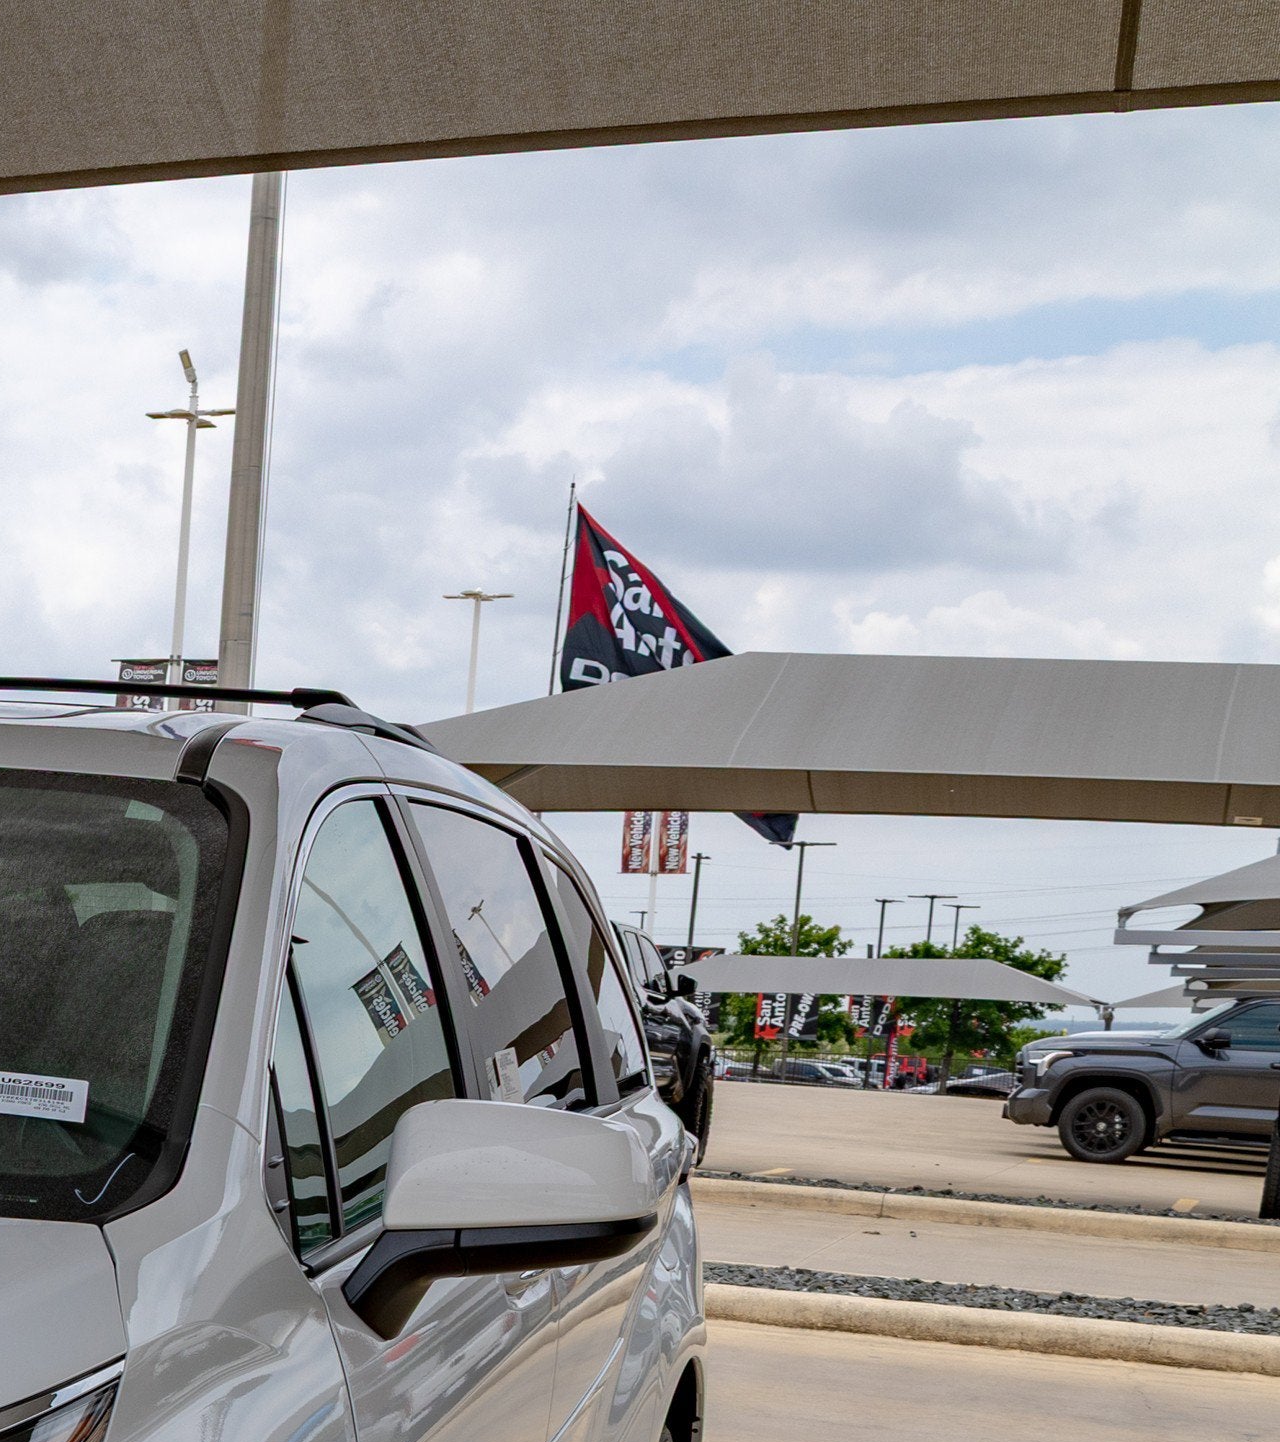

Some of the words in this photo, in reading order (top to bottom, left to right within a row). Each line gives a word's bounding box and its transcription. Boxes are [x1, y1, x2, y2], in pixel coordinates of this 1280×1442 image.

[628, 848, 643, 869] New
[665, 848, 680, 869] New
[757, 1000, 773, 1026] San
[788, 992, 815, 1037] PRE-OW
[1, 1077, 67, 1090] U62599
